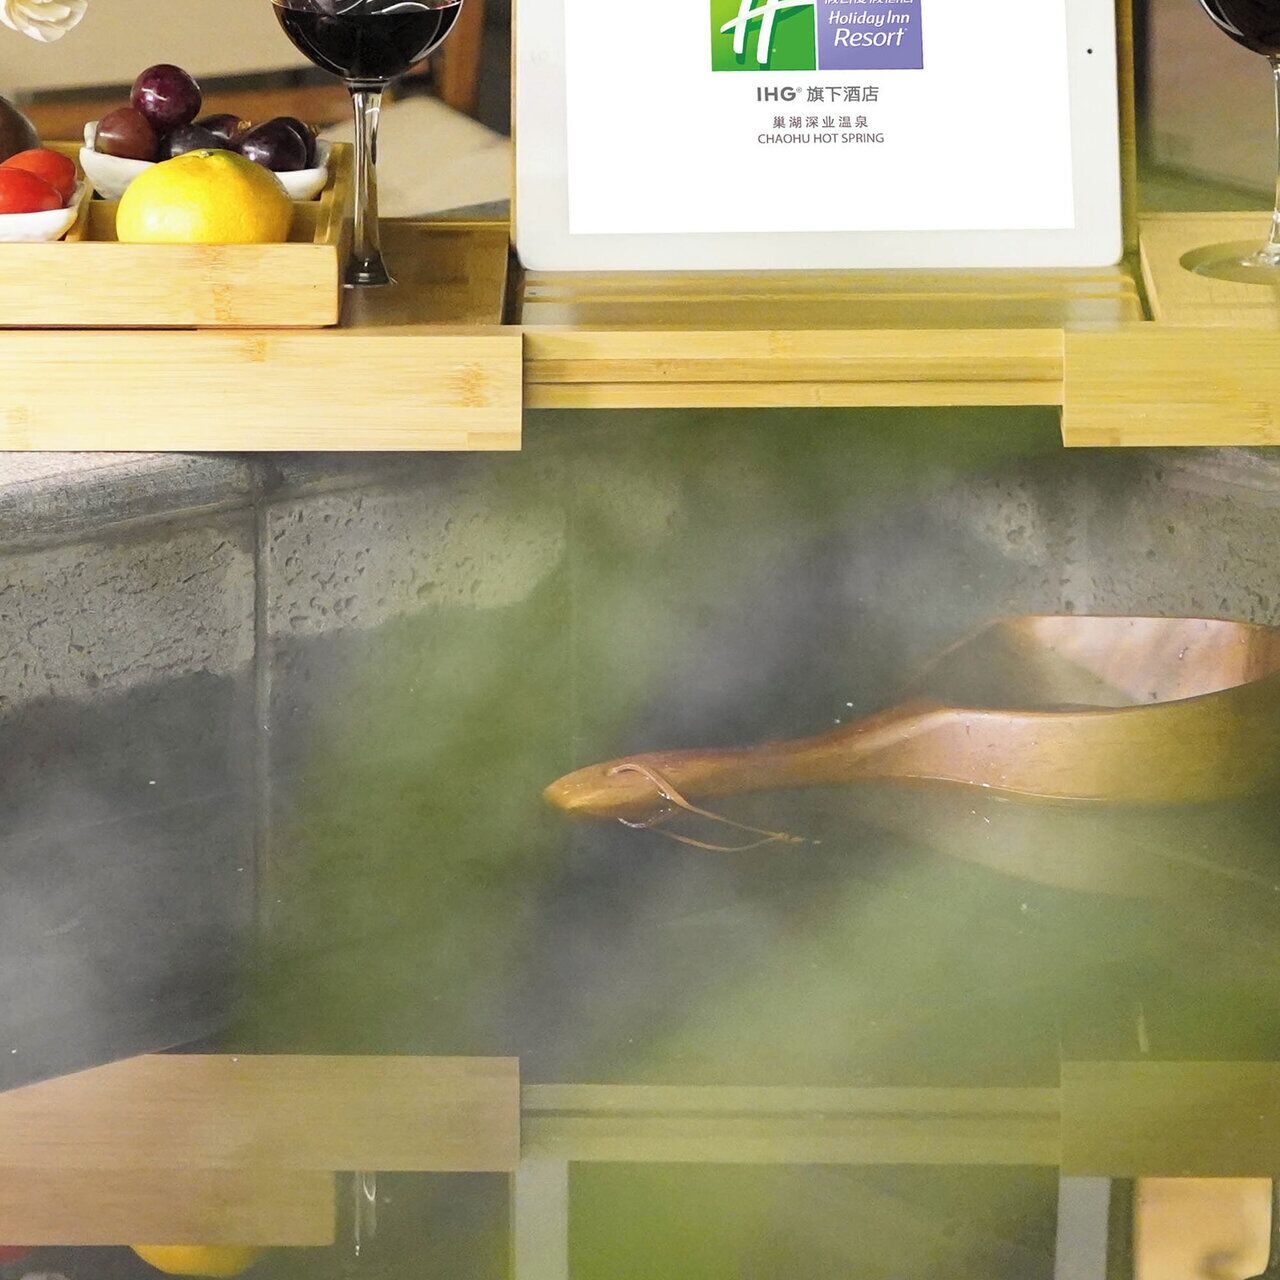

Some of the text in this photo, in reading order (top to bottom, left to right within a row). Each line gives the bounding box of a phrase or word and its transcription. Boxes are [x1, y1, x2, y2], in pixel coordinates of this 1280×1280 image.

[828, 10, 910, 27] Holiday Inn
[834, 28, 904, 47] Resort
[806, 85, 879, 103] 旗下酒店
[772, 115, 868, 129] 巢湖深业温泉
[757, 132, 885, 144] CHAOHU HOT SPRING
